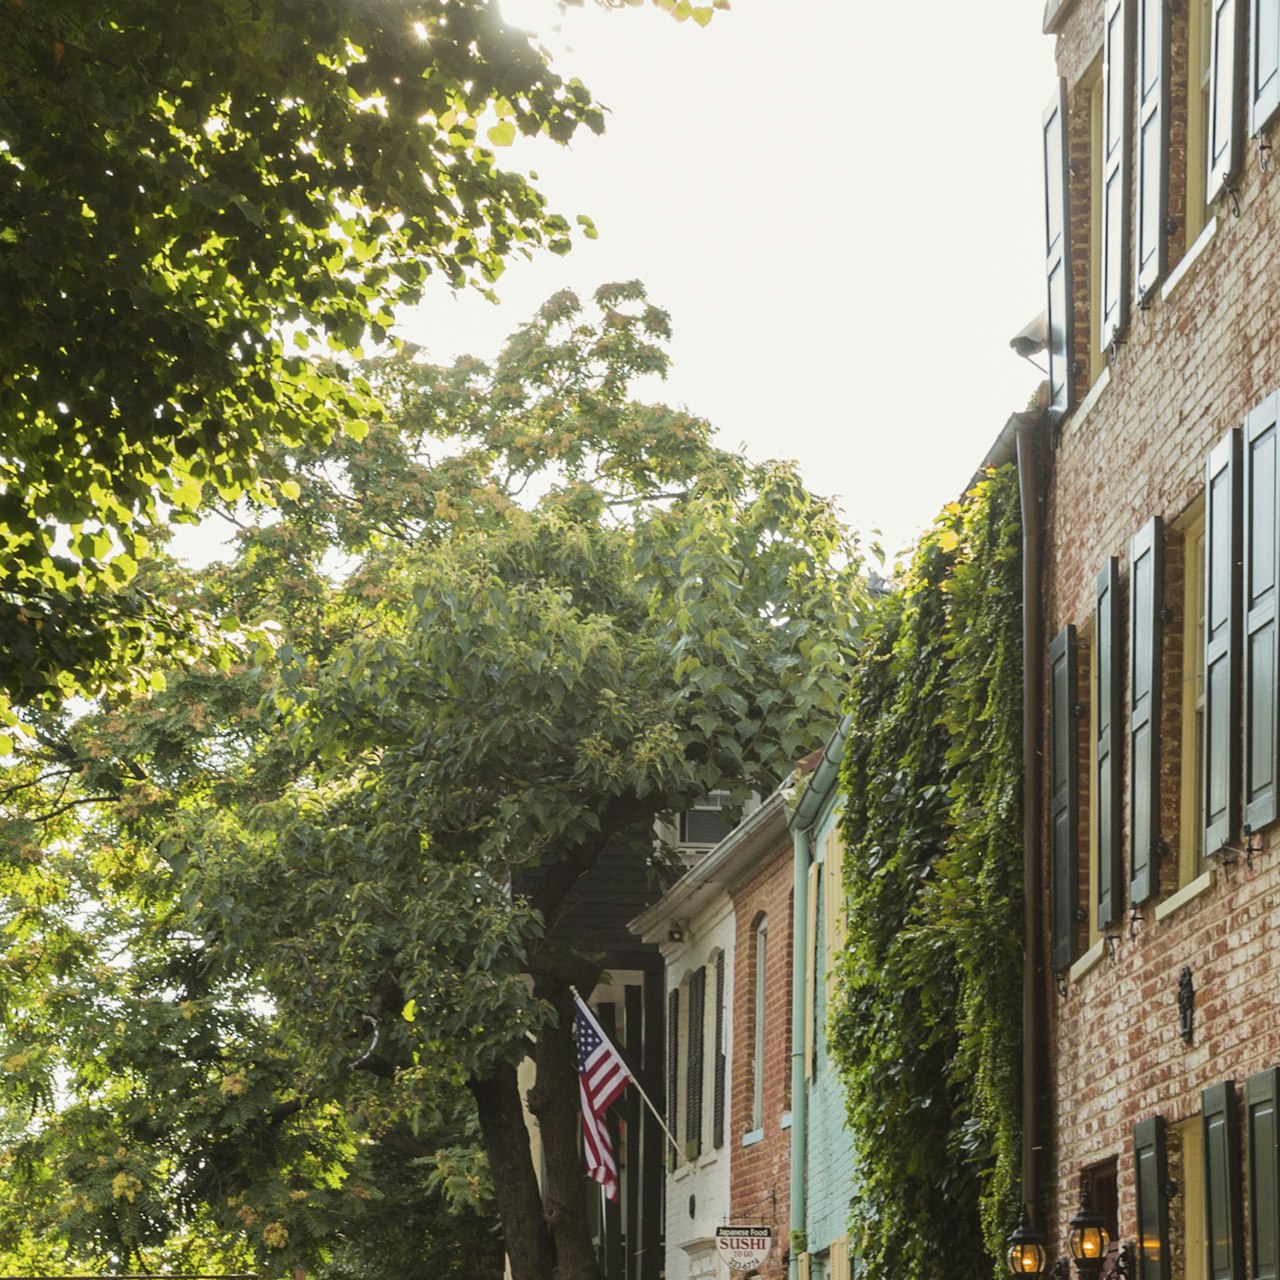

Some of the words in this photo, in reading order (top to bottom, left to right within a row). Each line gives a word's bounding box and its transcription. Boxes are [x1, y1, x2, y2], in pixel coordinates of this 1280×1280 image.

[719, 1228, 750, 1237] Japanese
[750, 1228, 768, 1237] Food
[720, 1238, 766, 1249] SUSHI
